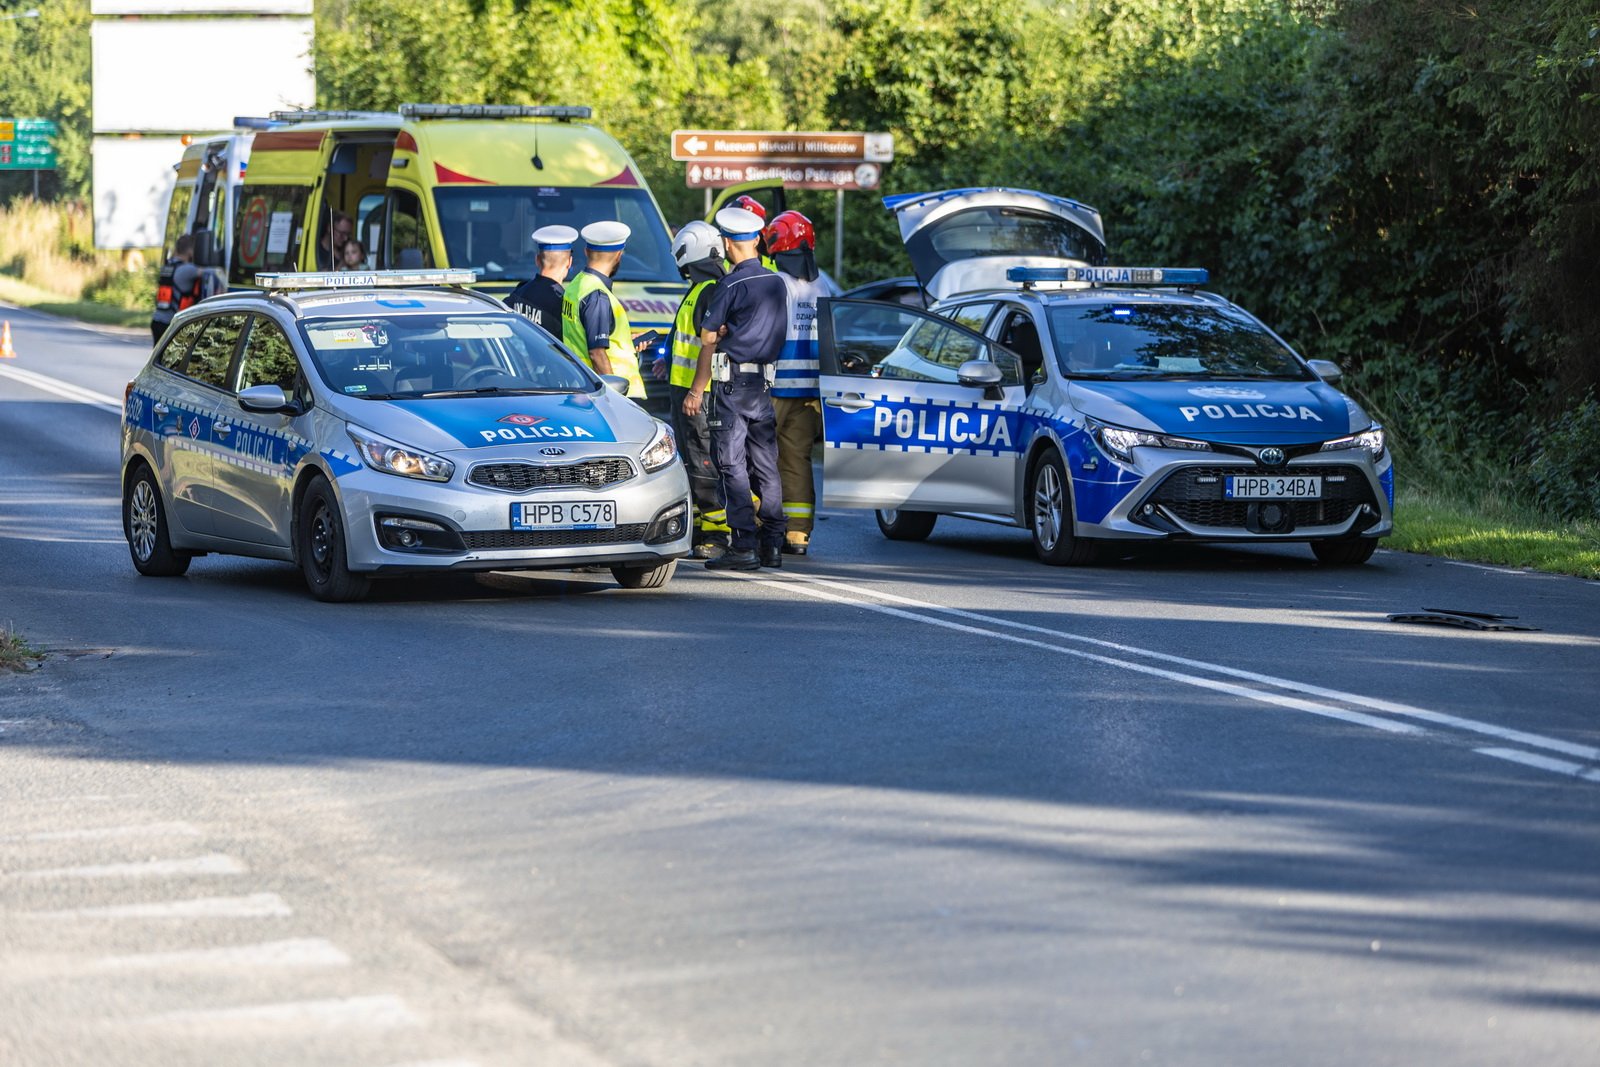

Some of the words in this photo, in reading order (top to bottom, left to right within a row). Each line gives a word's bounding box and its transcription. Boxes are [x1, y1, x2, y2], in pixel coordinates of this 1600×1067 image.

[798, 140, 804, 152] i
[723, 166, 743, 181] km
[326, 276, 374, 285] POLICJA
[1078, 269, 1130, 282] POLICJA
[513, 302, 542, 325] OLICJA
[1179, 404, 1323, 422] POLICJA
[480, 426, 594, 442] POLICJA
[873, 406, 1012, 447] POLICJA
[235, 430, 274, 465] POLICJA
[543, 447, 562, 455] KIA
[1237, 478, 1269, 496] HPB
[1276, 478, 1316, 496] 34BA
[524, 505, 564, 524] HPB
[570, 503, 612, 523] C578
